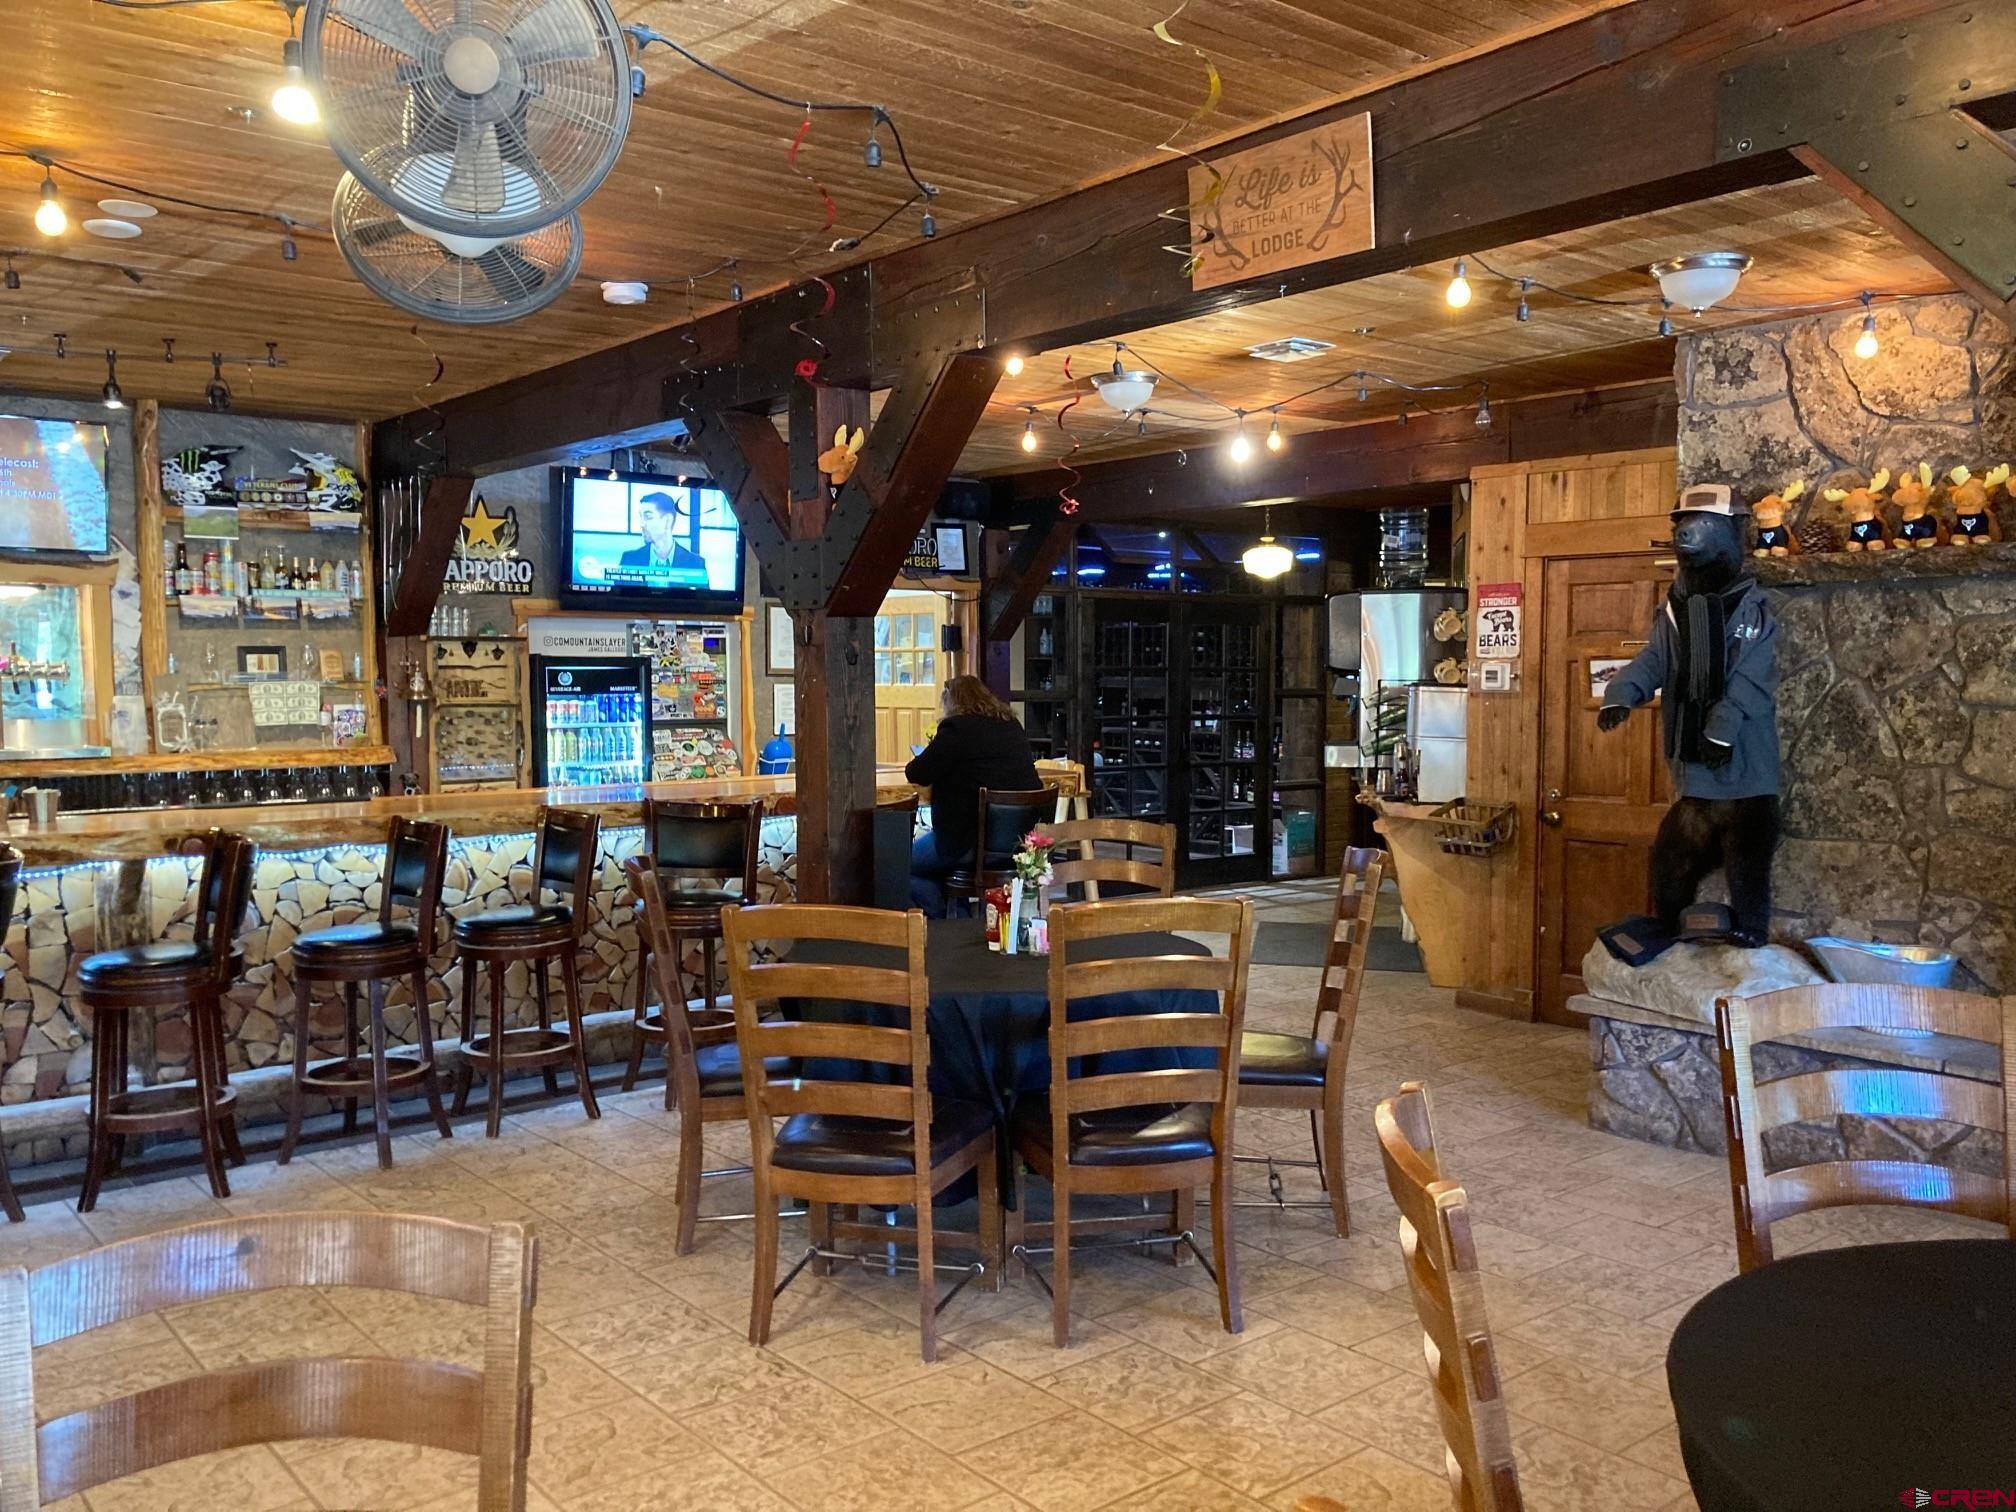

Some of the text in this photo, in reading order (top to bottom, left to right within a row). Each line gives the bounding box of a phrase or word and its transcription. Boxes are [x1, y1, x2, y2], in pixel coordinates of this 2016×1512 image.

[1235, 159, 1322, 210] Life is
[1232, 199, 1321, 235] BETTER AT THE
[1252, 228, 1304, 258] LODGE
[444, 559, 532, 583] APPORO
[443, 581, 530, 593] REMIUM BEER
[1480, 596, 1518, 607] STRONGER
[1479, 633, 1517, 647] BEARS
